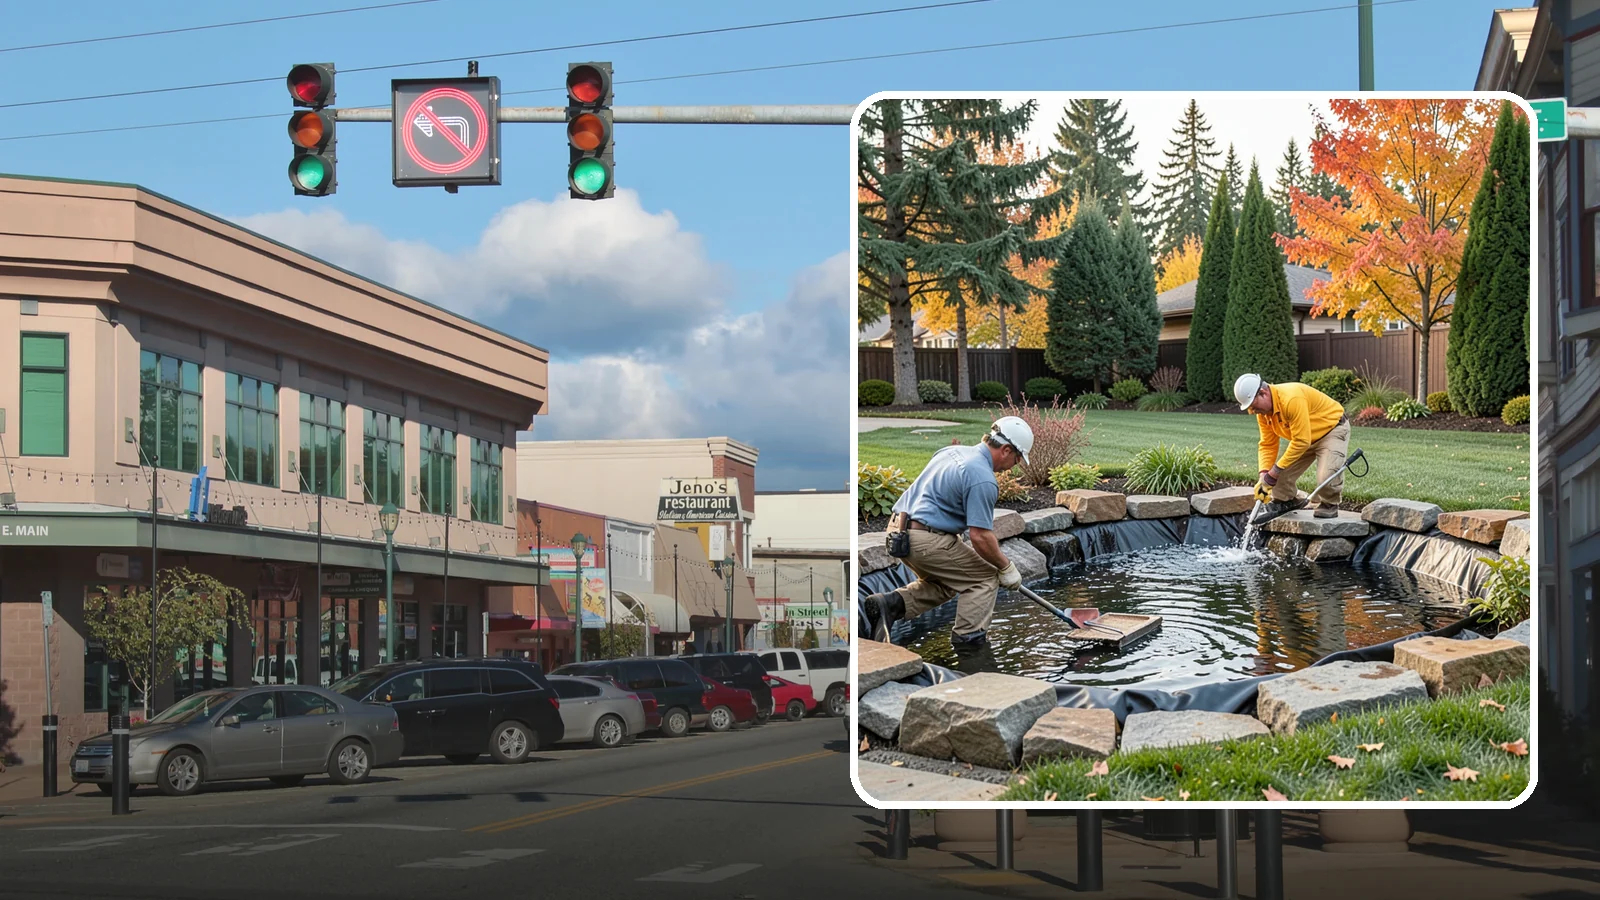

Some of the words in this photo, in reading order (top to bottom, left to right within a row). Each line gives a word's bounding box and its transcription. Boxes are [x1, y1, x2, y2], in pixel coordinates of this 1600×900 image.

[670, 480, 727, 494] Jeno's
[665, 496, 730, 509] restaurant
[659, 510, 681, 519] Italian
[686, 510, 714, 519] American
[715, 509, 738, 519] Cuisine
[2, 525, 13, 536] E.
[16, 525, 49, 536] MAIN
[786, 608, 795, 616] in
[797, 608, 828, 616] Street
[791, 619, 824, 627] lass
